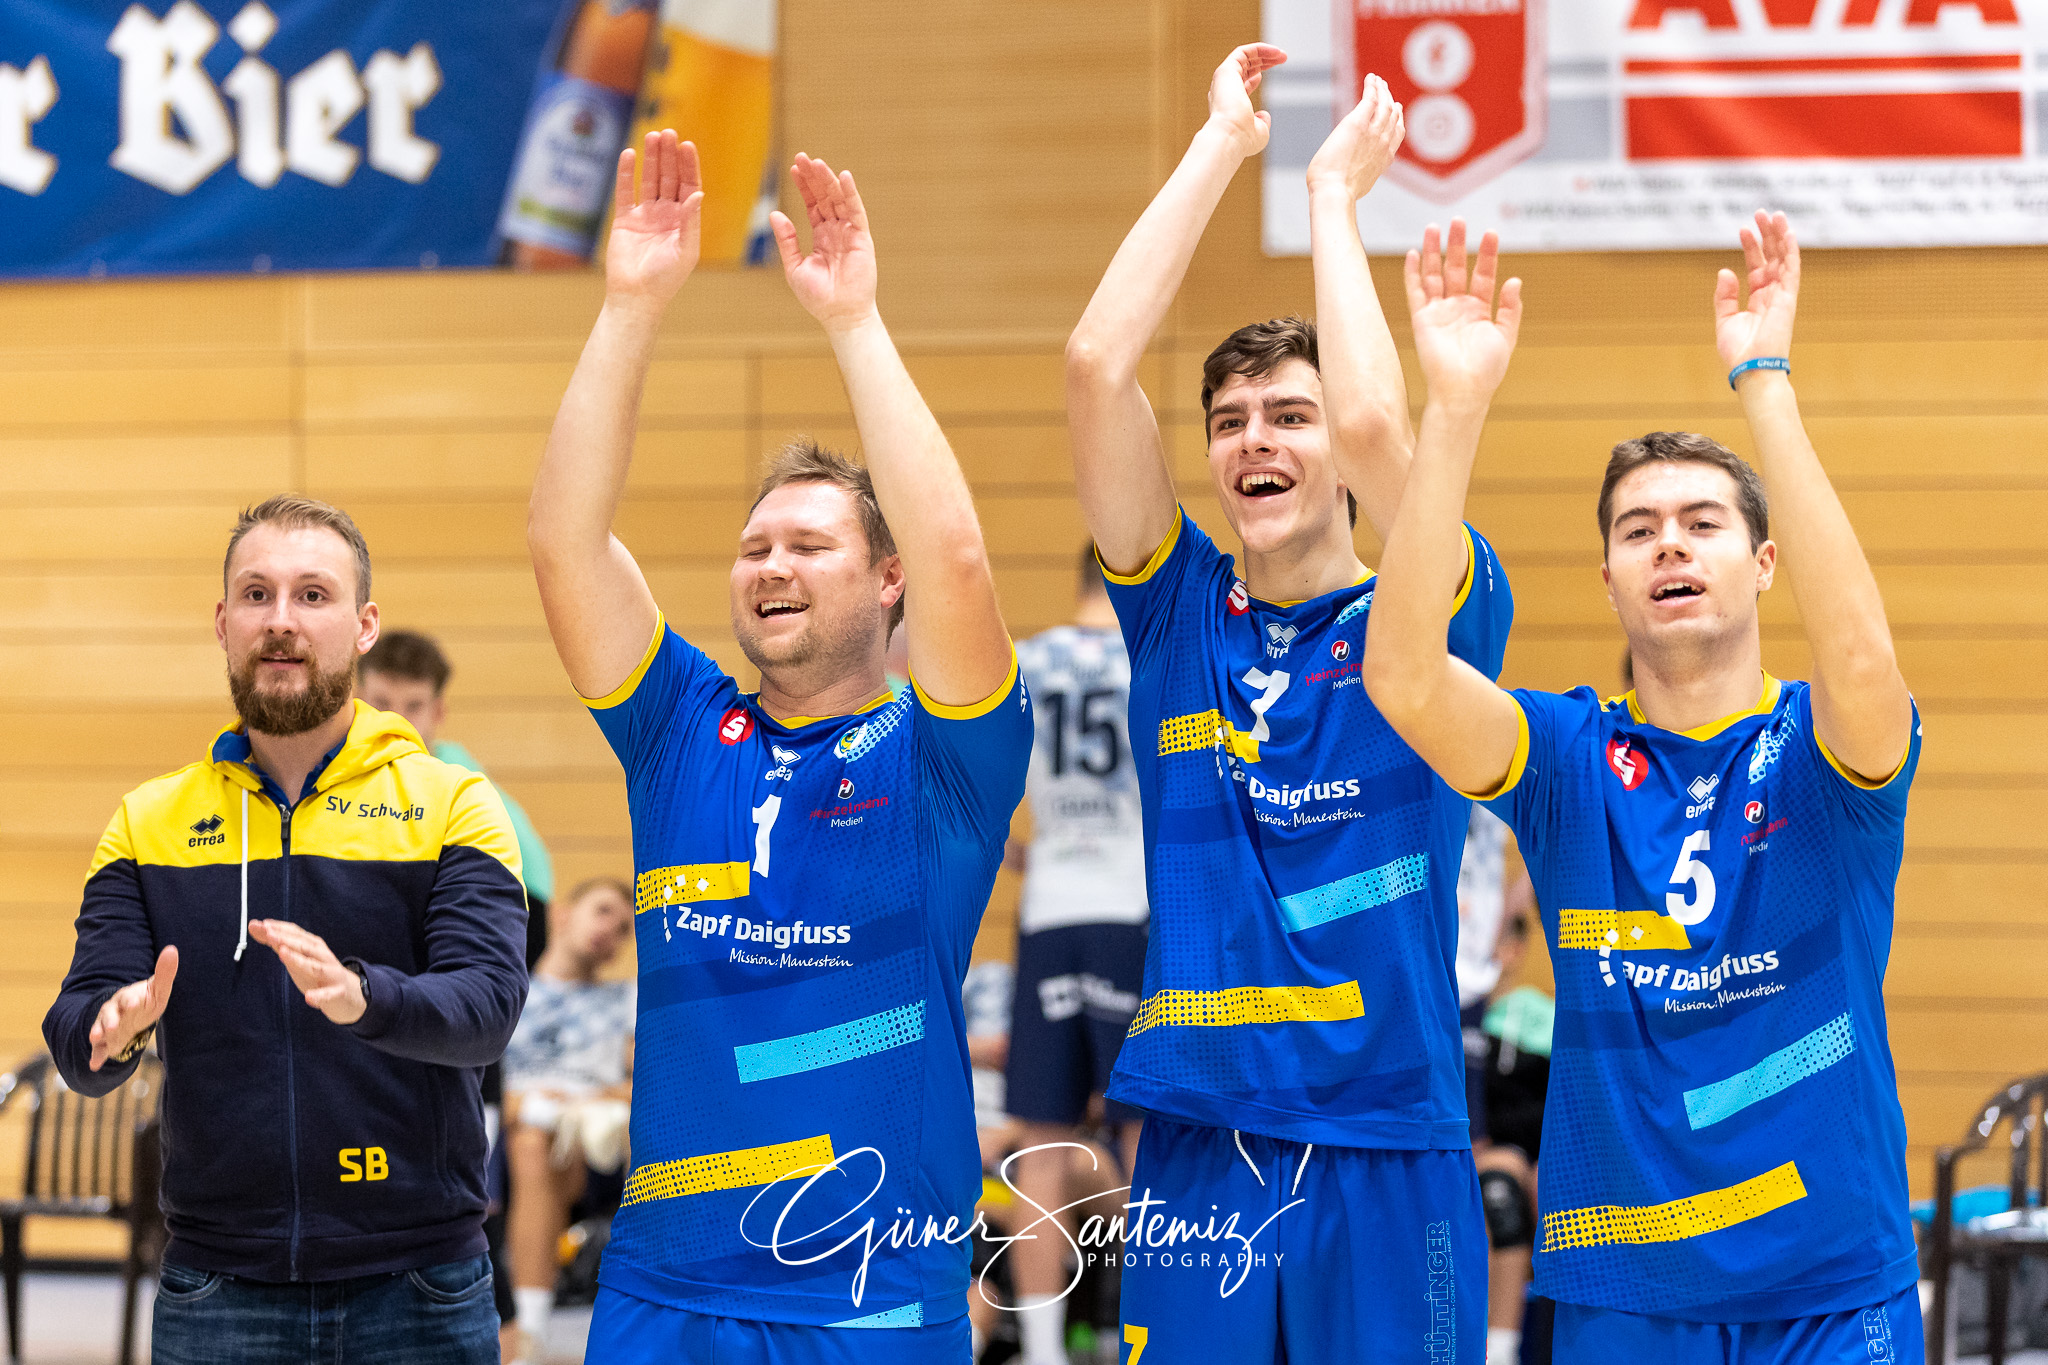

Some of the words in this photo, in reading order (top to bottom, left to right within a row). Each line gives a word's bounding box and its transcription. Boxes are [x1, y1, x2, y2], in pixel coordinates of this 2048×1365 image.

[106, 0, 444, 197] Bier
[1305, 661, 1363, 687] Heinzelm
[1242, 667, 1290, 742] 7
[1042, 686, 1120, 778] 15
[325, 795, 351, 814] SV
[357, 804, 424, 822] Schwaig
[1248, 777, 1361, 810] Daigfuss
[752, 793, 783, 878] 1
[830, 816, 864, 828] Medien
[1254, 807, 1292, 827] ission:
[188, 832, 225, 848] errea
[1665, 829, 1716, 926] 5
[676, 905, 733, 939] Zapf
[734, 917, 852, 950] Daigfuss
[1622, 961, 1671, 989] apf
[1669, 950, 1779, 992] Daigfuss
[338, 1146, 390, 1183] SB
